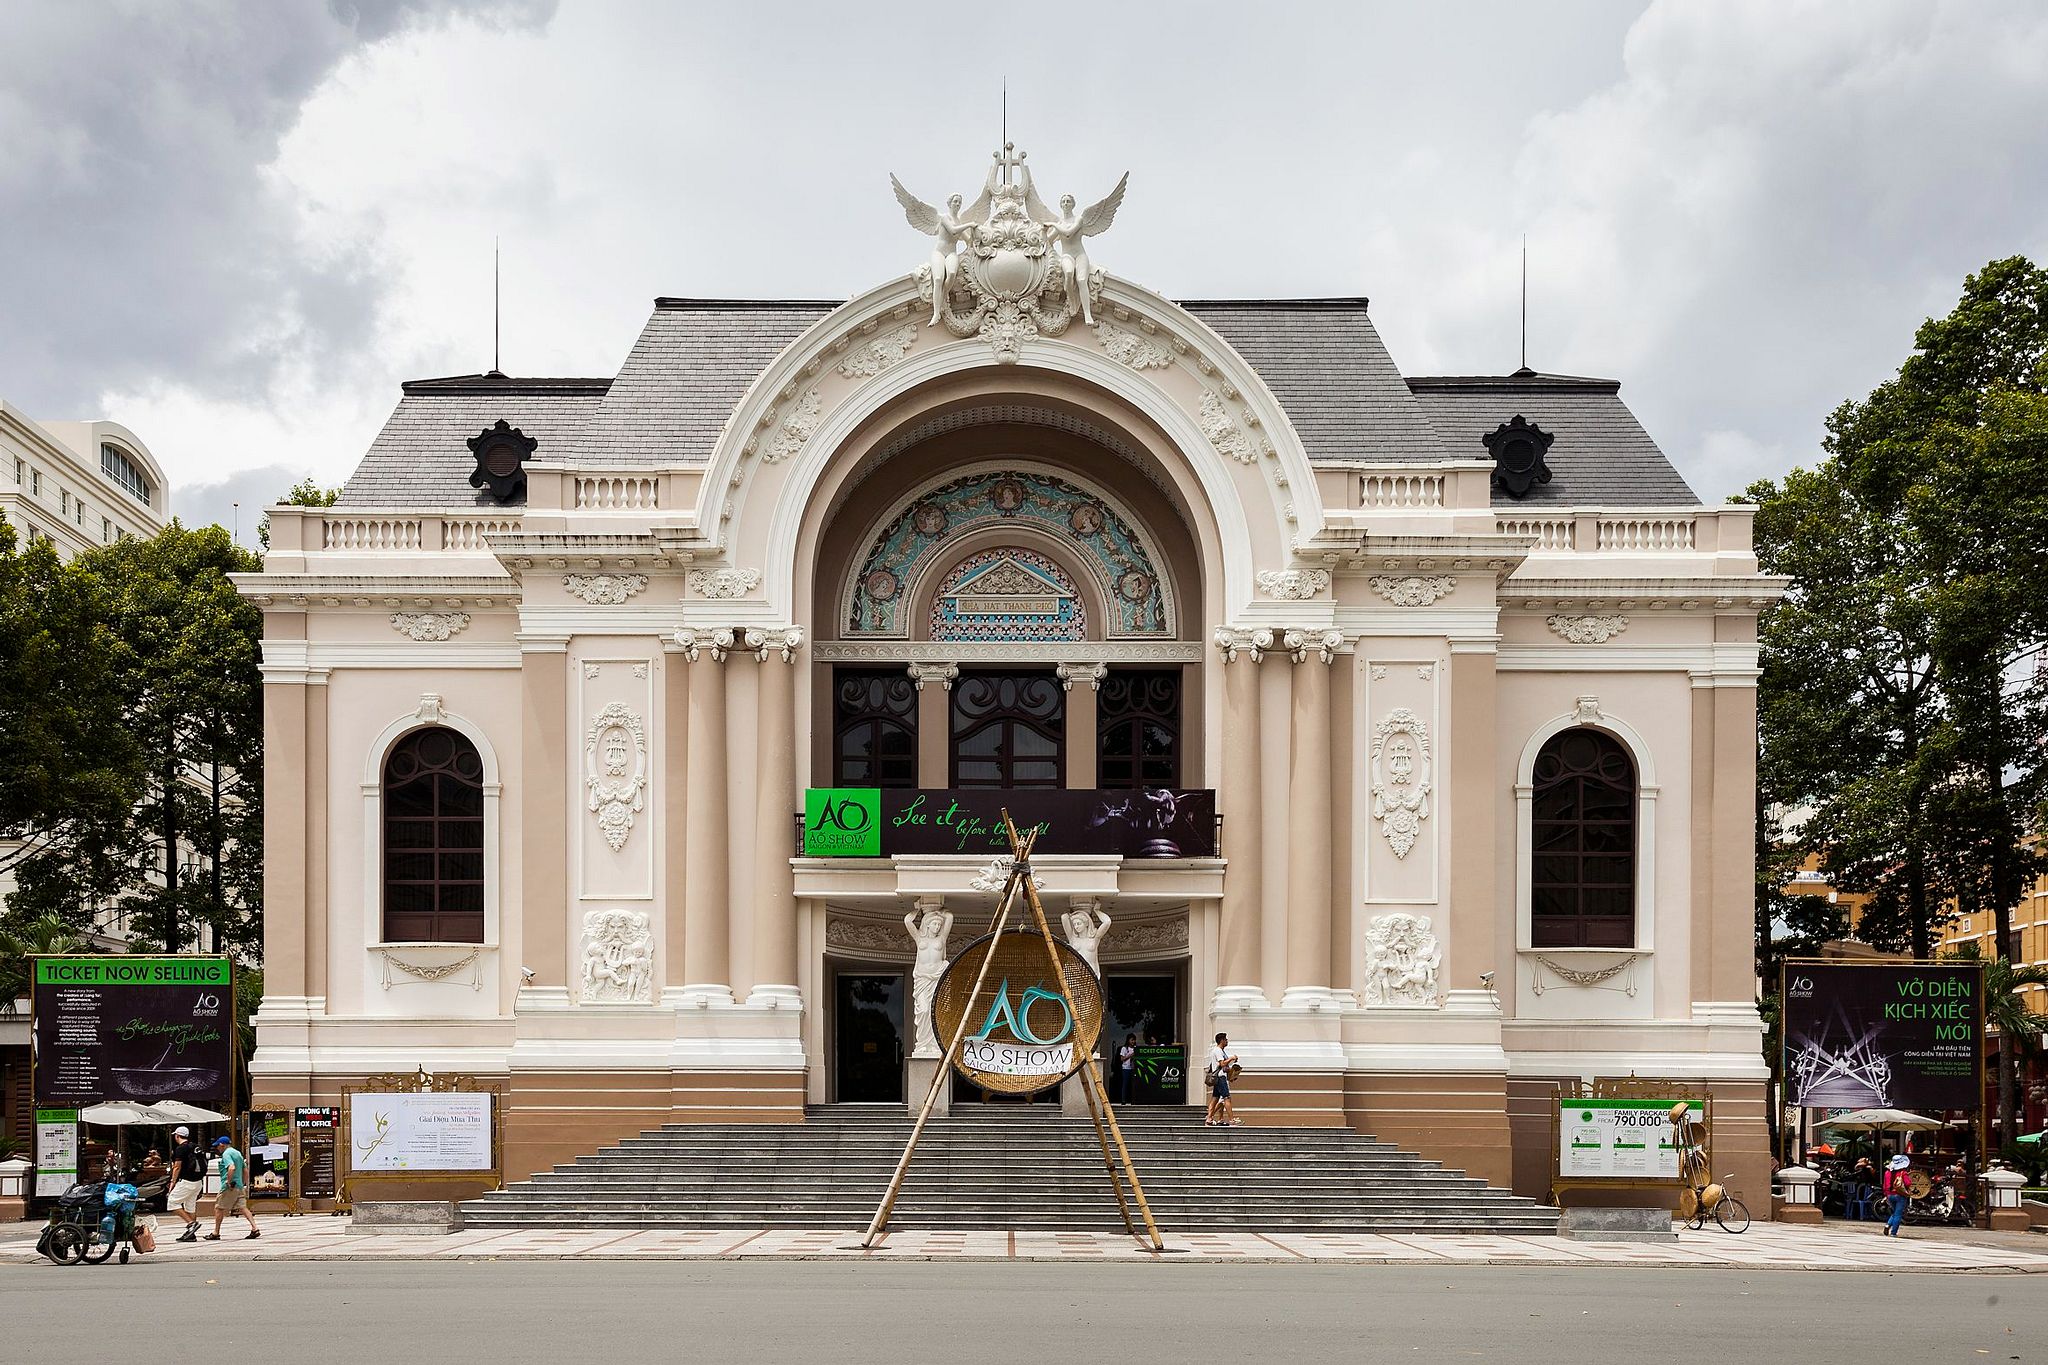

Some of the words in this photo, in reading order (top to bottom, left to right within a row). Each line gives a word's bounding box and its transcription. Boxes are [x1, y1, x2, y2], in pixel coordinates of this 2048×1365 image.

[893, 795, 927, 827] See
[936, 798, 964, 826] it
[828, 834, 867, 844] SHOW
[956, 818, 987, 850] before
[46, 966, 100, 980] TICKET
[105, 967, 149, 980] NOW
[154, 967, 221, 981] SELLING
[1897, 977, 1924, 997] VỞ
[1928, 976, 1970, 997] DIỄN
[1885, 1003, 1926, 1022] KỊCH
[1931, 999, 1970, 1019] XIẾC
[1936, 1022, 1971, 1040] MỚI
[1000, 1048, 1071, 1066] SHOW
[964, 1058, 1004, 1073] SAIGON
[1015, 1064, 1065, 1075] VIETNAM
[1614, 1116, 1661, 1127] 790.000
